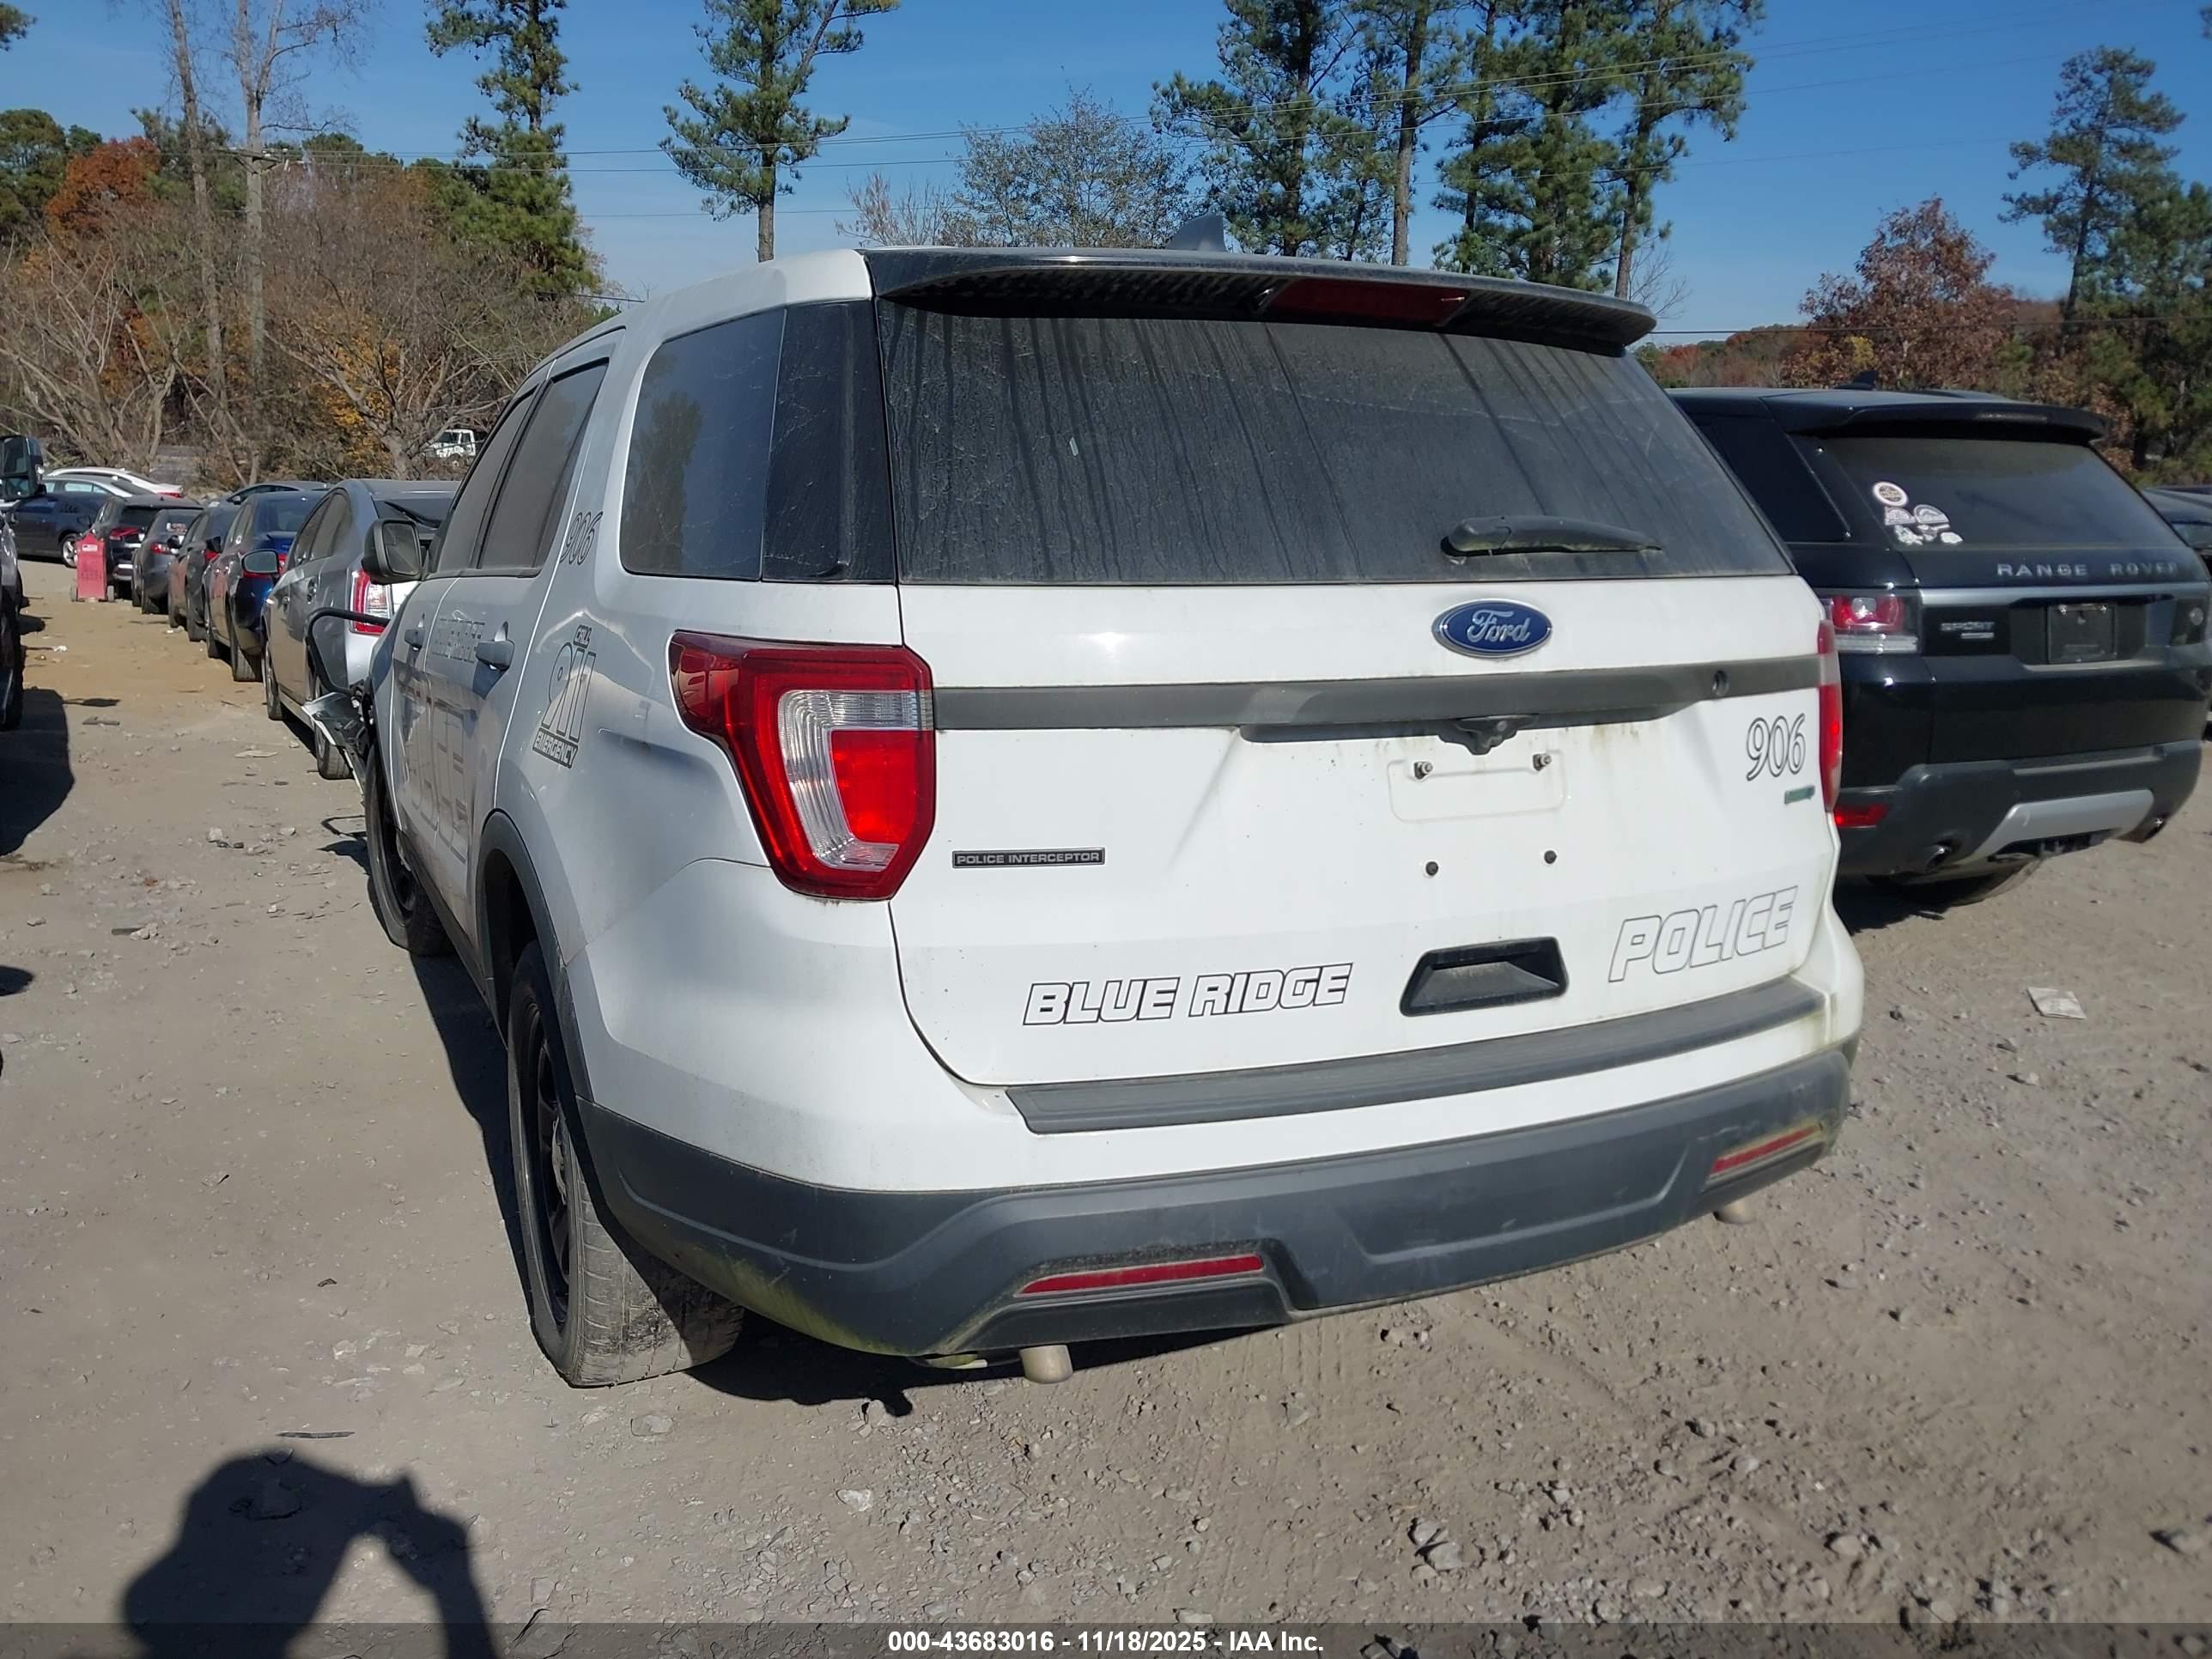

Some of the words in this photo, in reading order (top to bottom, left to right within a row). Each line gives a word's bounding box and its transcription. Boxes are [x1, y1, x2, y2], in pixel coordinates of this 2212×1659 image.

[560, 511, 604, 565] 906
[1996, 563, 2088, 577] RANGE
[2110, 562, 2178, 576] ROVER
[574, 626, 592, 648] CALL
[1467, 609, 1531, 643] Ford
[1941, 621, 1995, 632] SPORT
[541, 642, 597, 744] 911
[532, 728, 579, 769] EMERGENCY
[1747, 713, 1806, 781] 906
[957, 854, 1005, 865] POLICE
[1008, 852, 1101, 864] INTERCEPTOR
[1607, 885, 1799, 983] POLICE
[1023, 976, 1181, 1026] BLUE
[1188, 962, 1354, 1018] RIDGE
